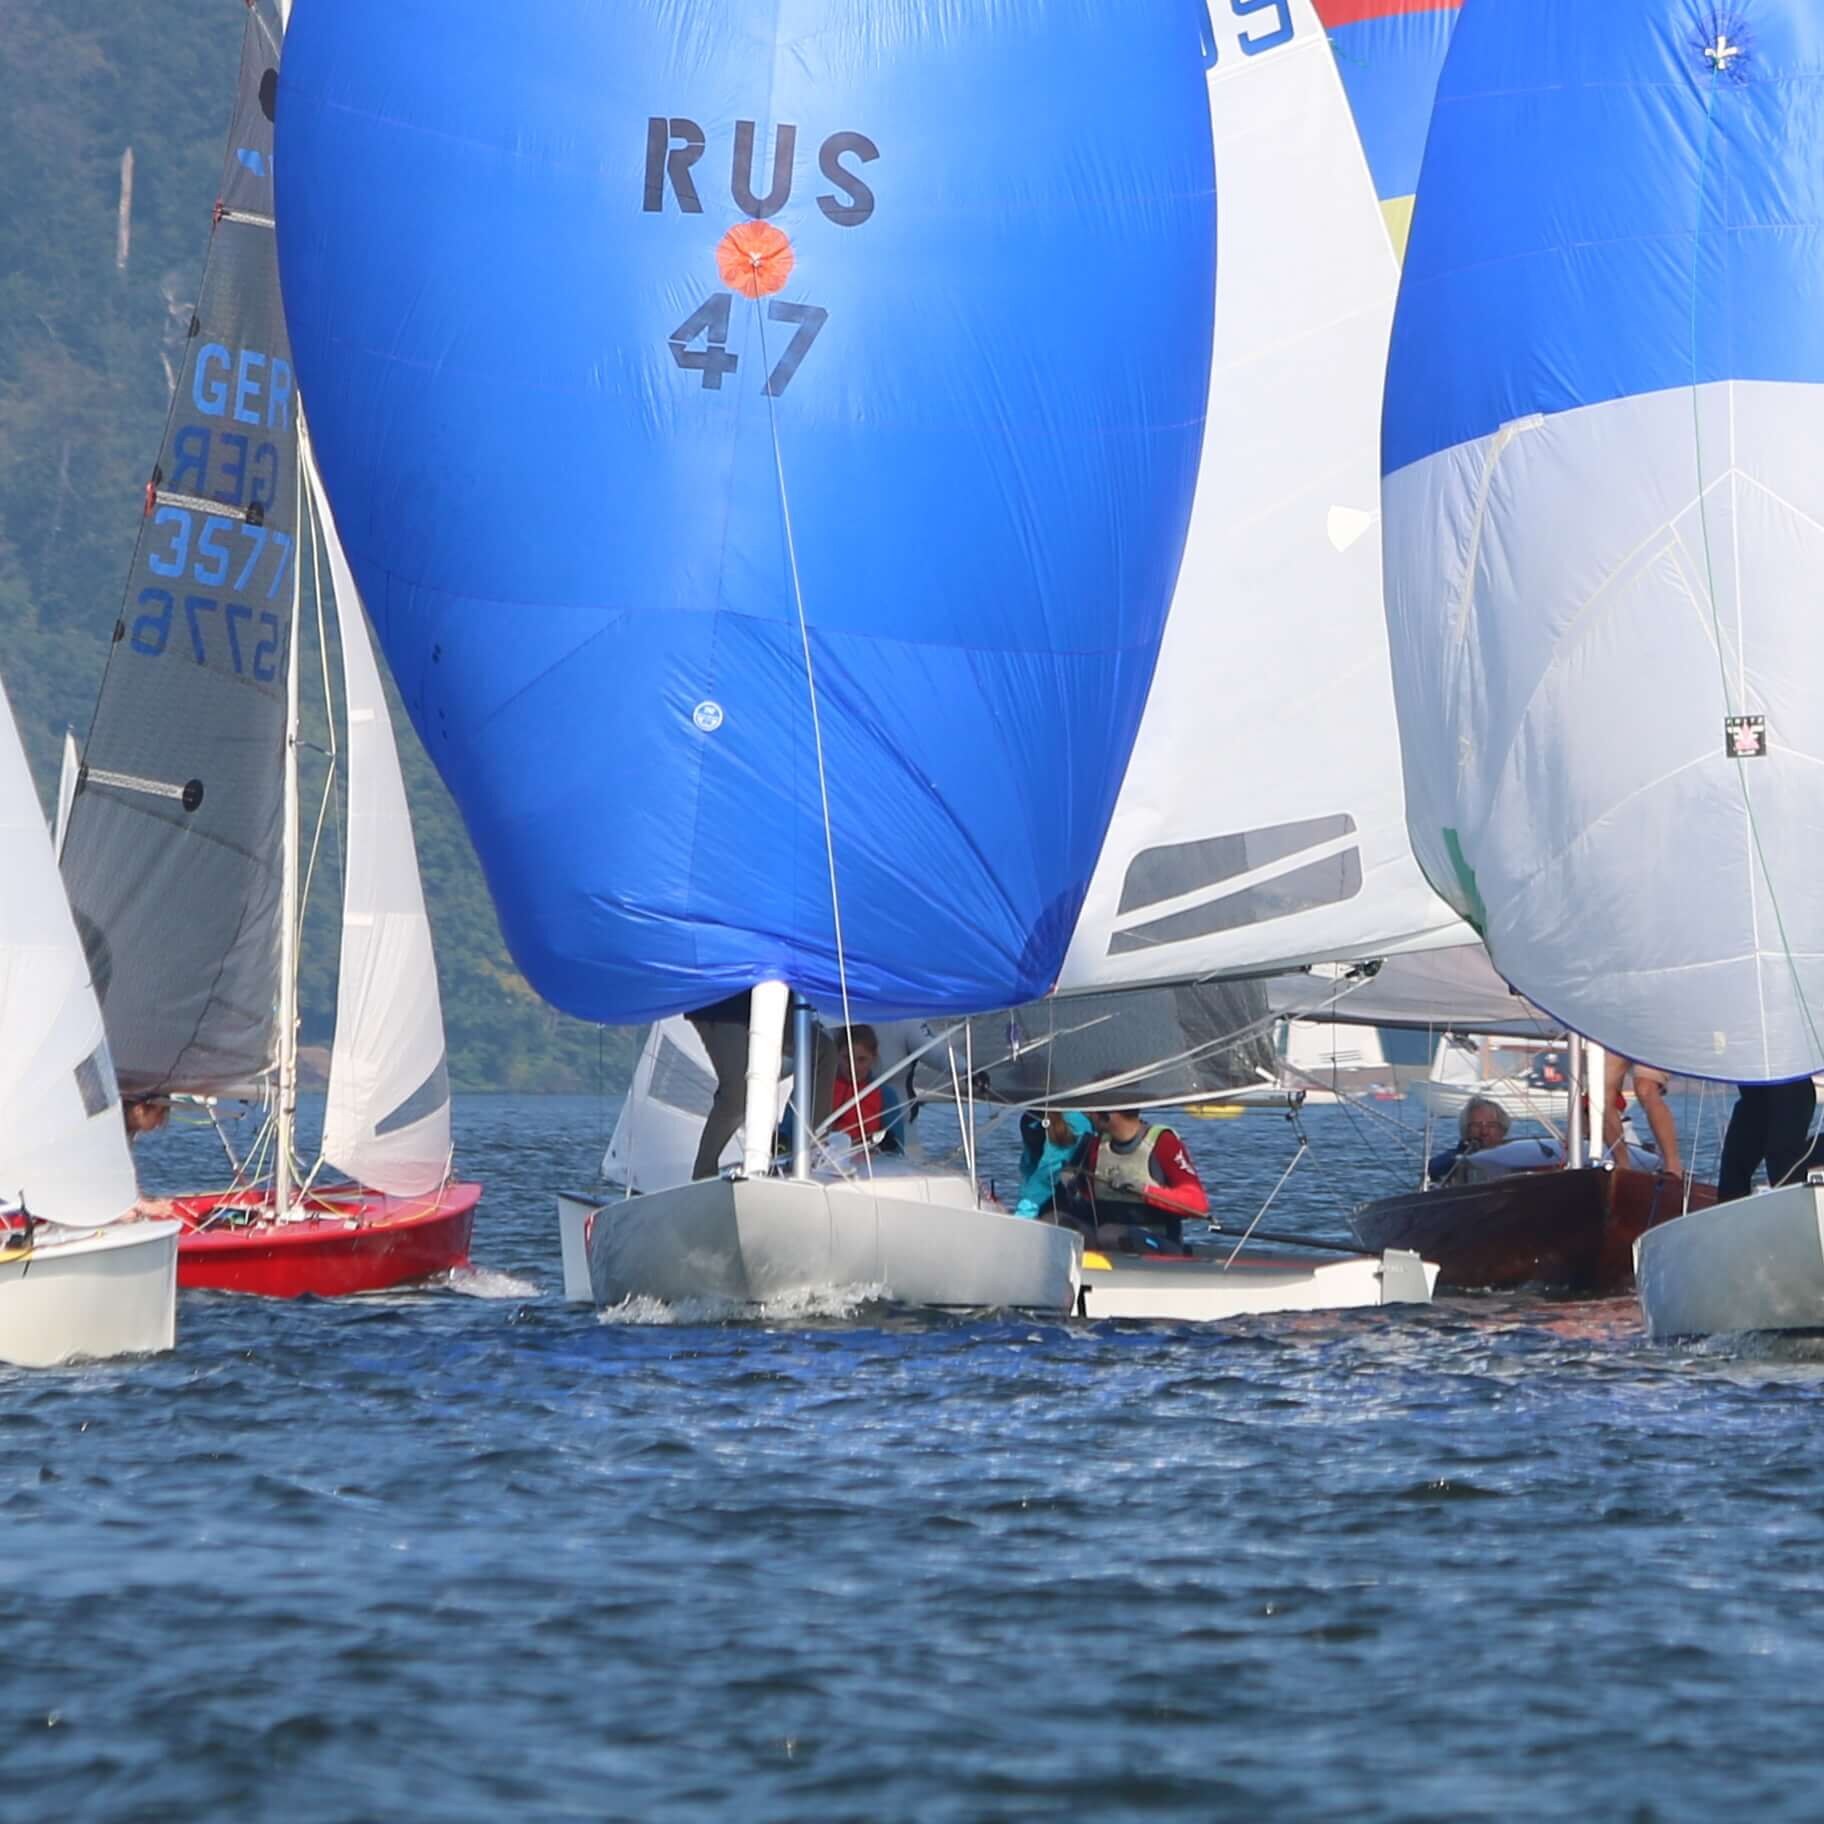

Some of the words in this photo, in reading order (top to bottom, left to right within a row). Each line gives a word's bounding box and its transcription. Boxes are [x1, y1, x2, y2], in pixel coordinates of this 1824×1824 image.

[643, 117, 880, 227] RUS
[192, 343, 291, 431] GER
[667, 292, 828, 397] 47
[148, 508, 294, 600] 3577
